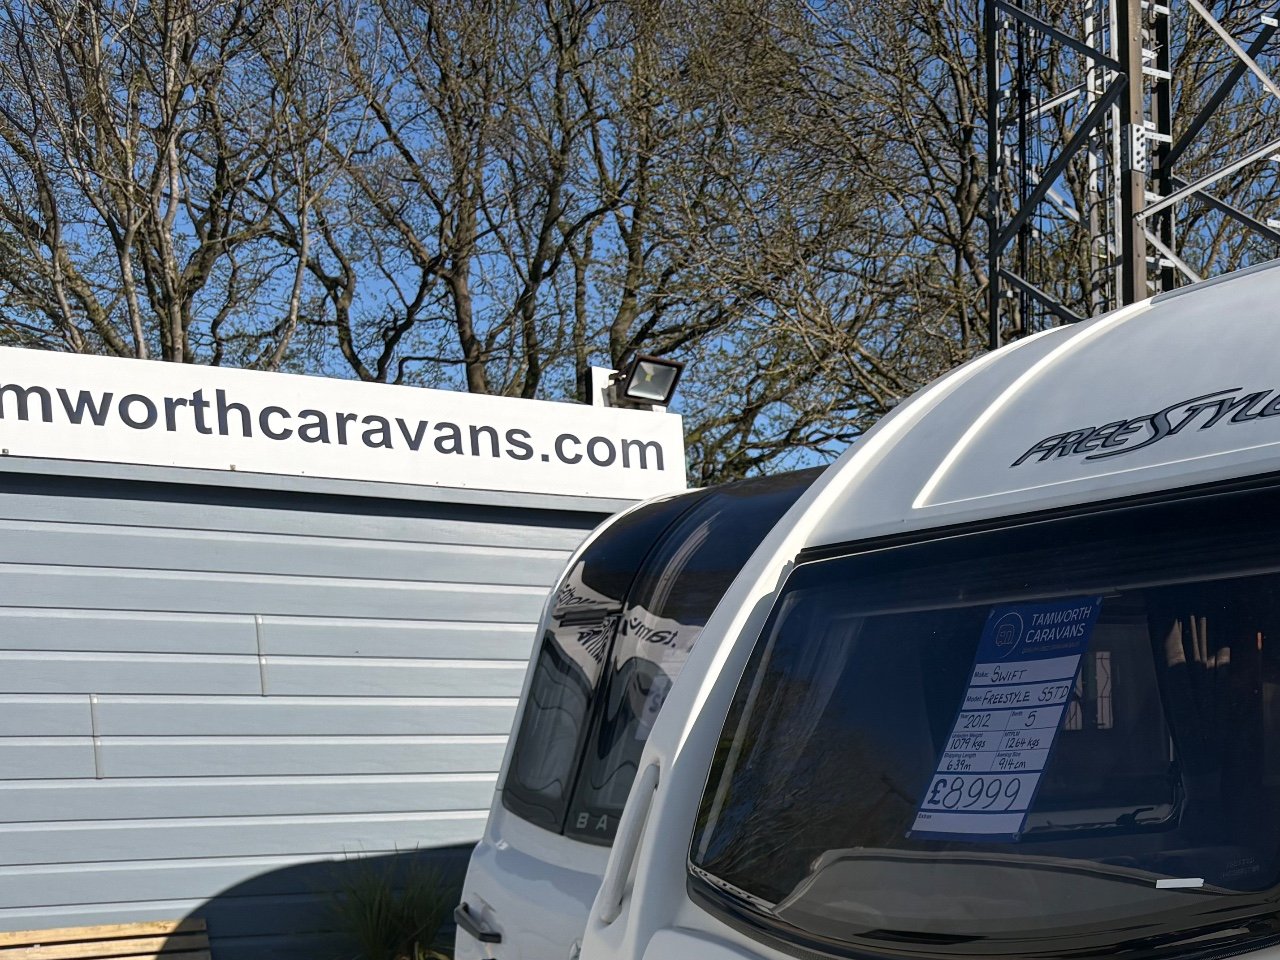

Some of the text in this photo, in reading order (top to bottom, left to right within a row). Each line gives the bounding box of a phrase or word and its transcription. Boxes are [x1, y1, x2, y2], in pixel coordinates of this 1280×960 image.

[1031, 606, 1092, 626] TAMWORTH
[1025, 623, 1085, 643] CARAVANS
[963, 713, 991, 729] 2012
[1024, 710, 1038, 727] 5
[950, 738, 971, 749] 1079
